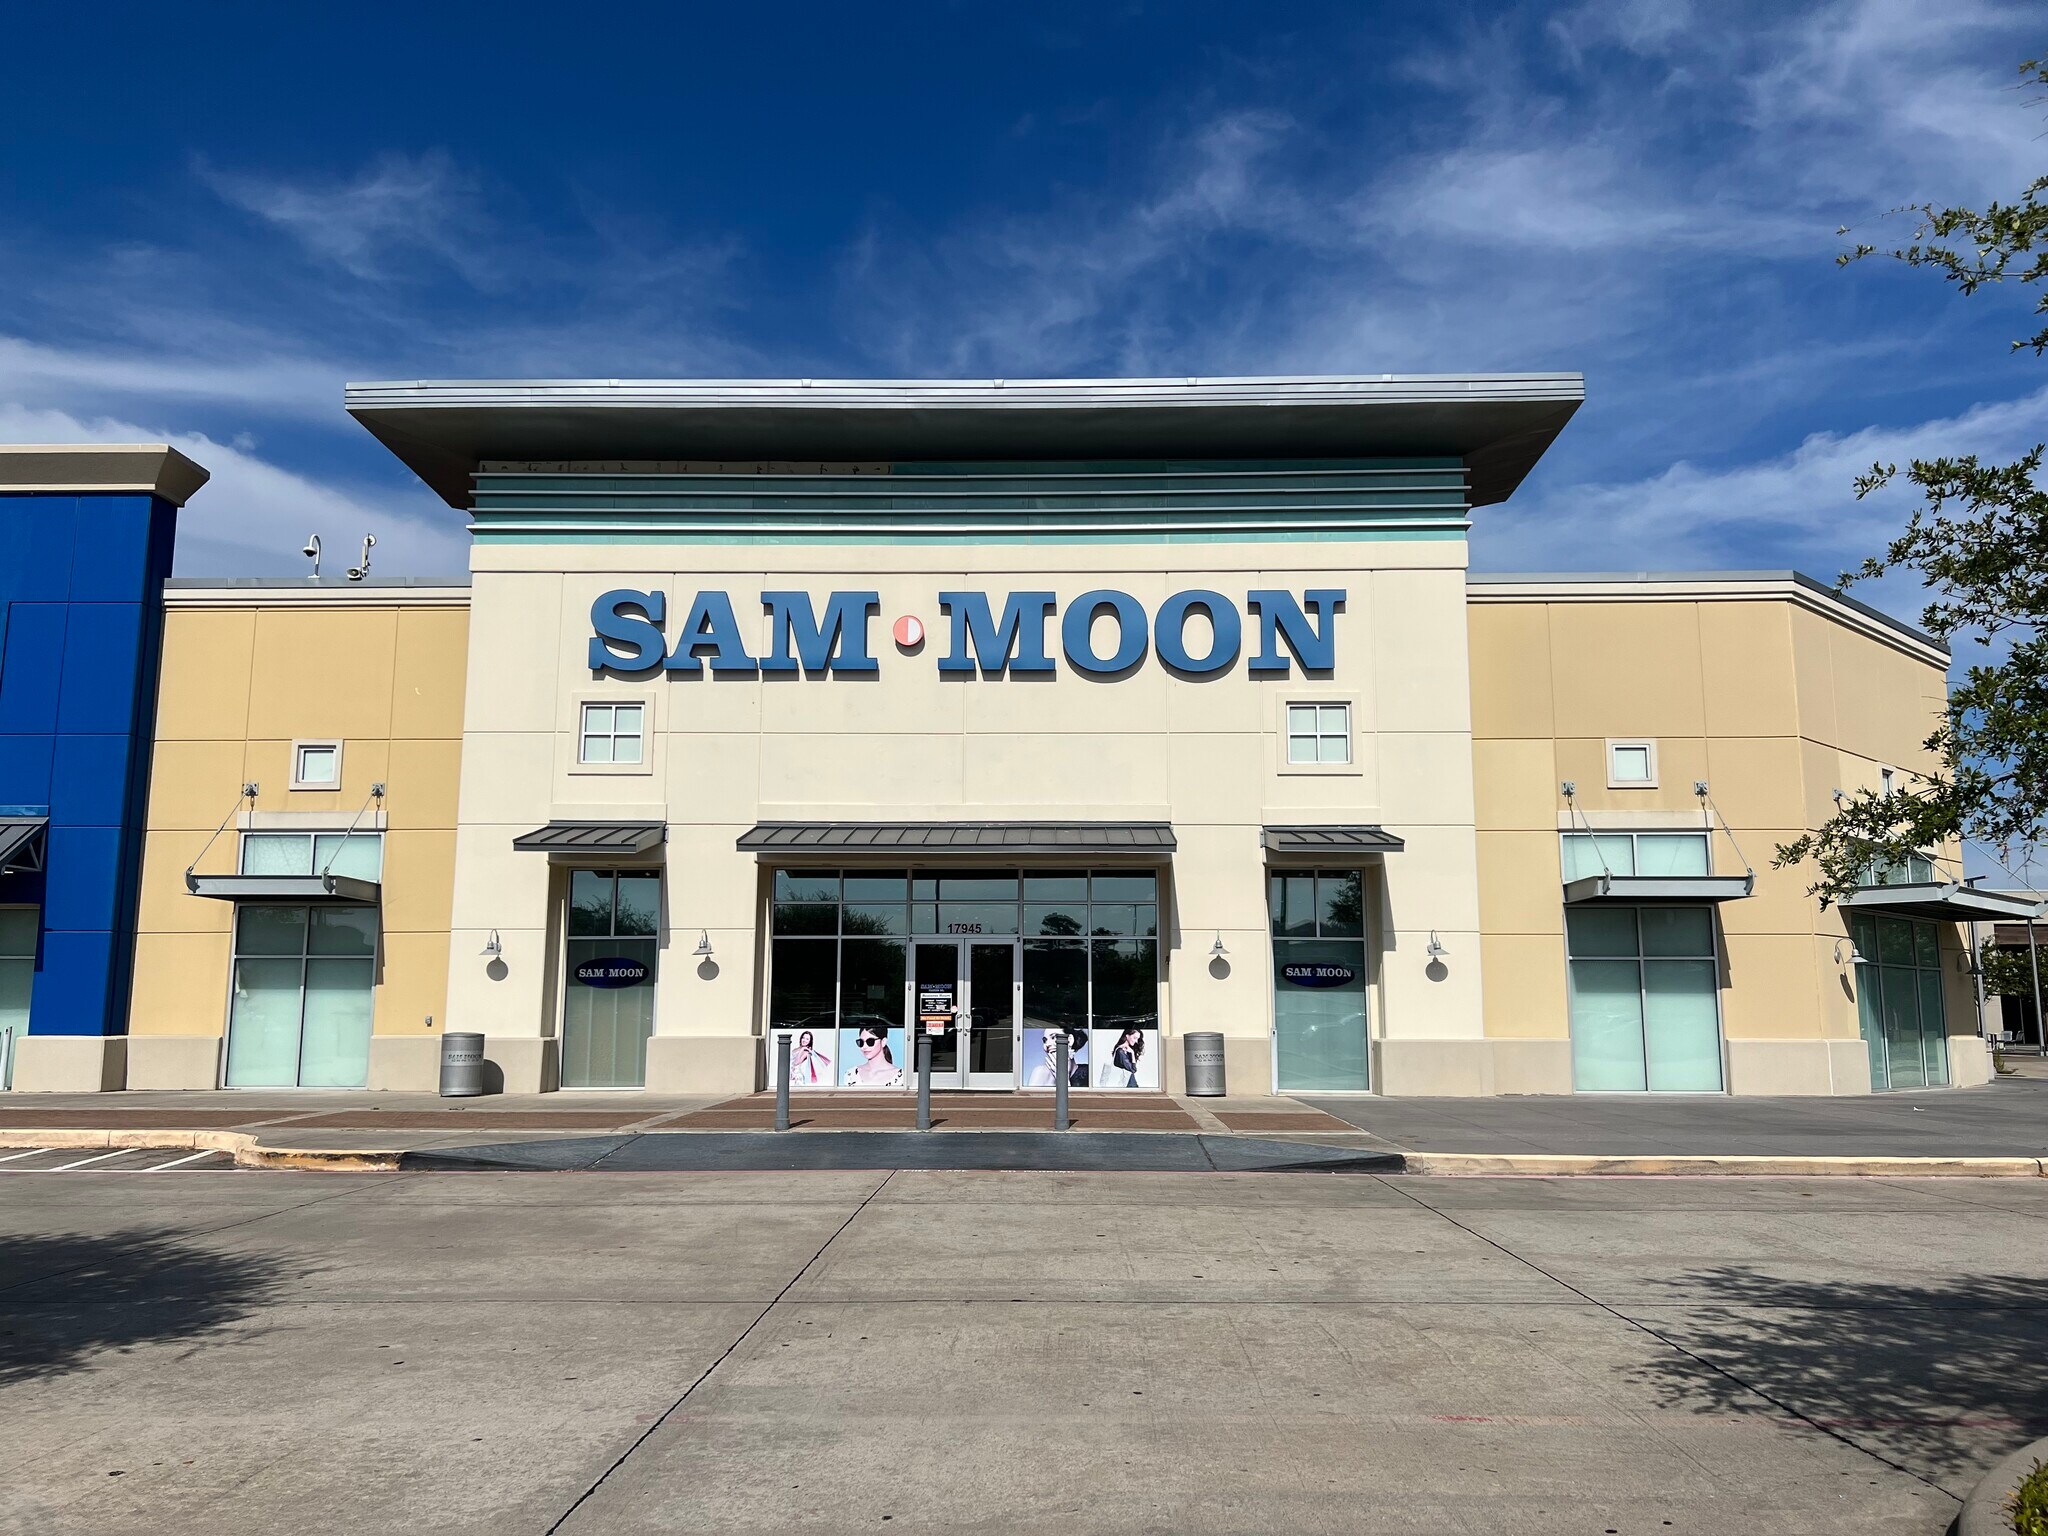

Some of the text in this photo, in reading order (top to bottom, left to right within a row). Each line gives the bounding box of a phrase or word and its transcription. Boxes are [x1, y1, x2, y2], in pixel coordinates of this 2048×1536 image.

[588, 589, 1347, 673] SAM MOON
[947, 923, 982, 934] 17945
[578, 968, 644, 978] SAM MOON
[1285, 967, 1351, 977] SAM MOON
